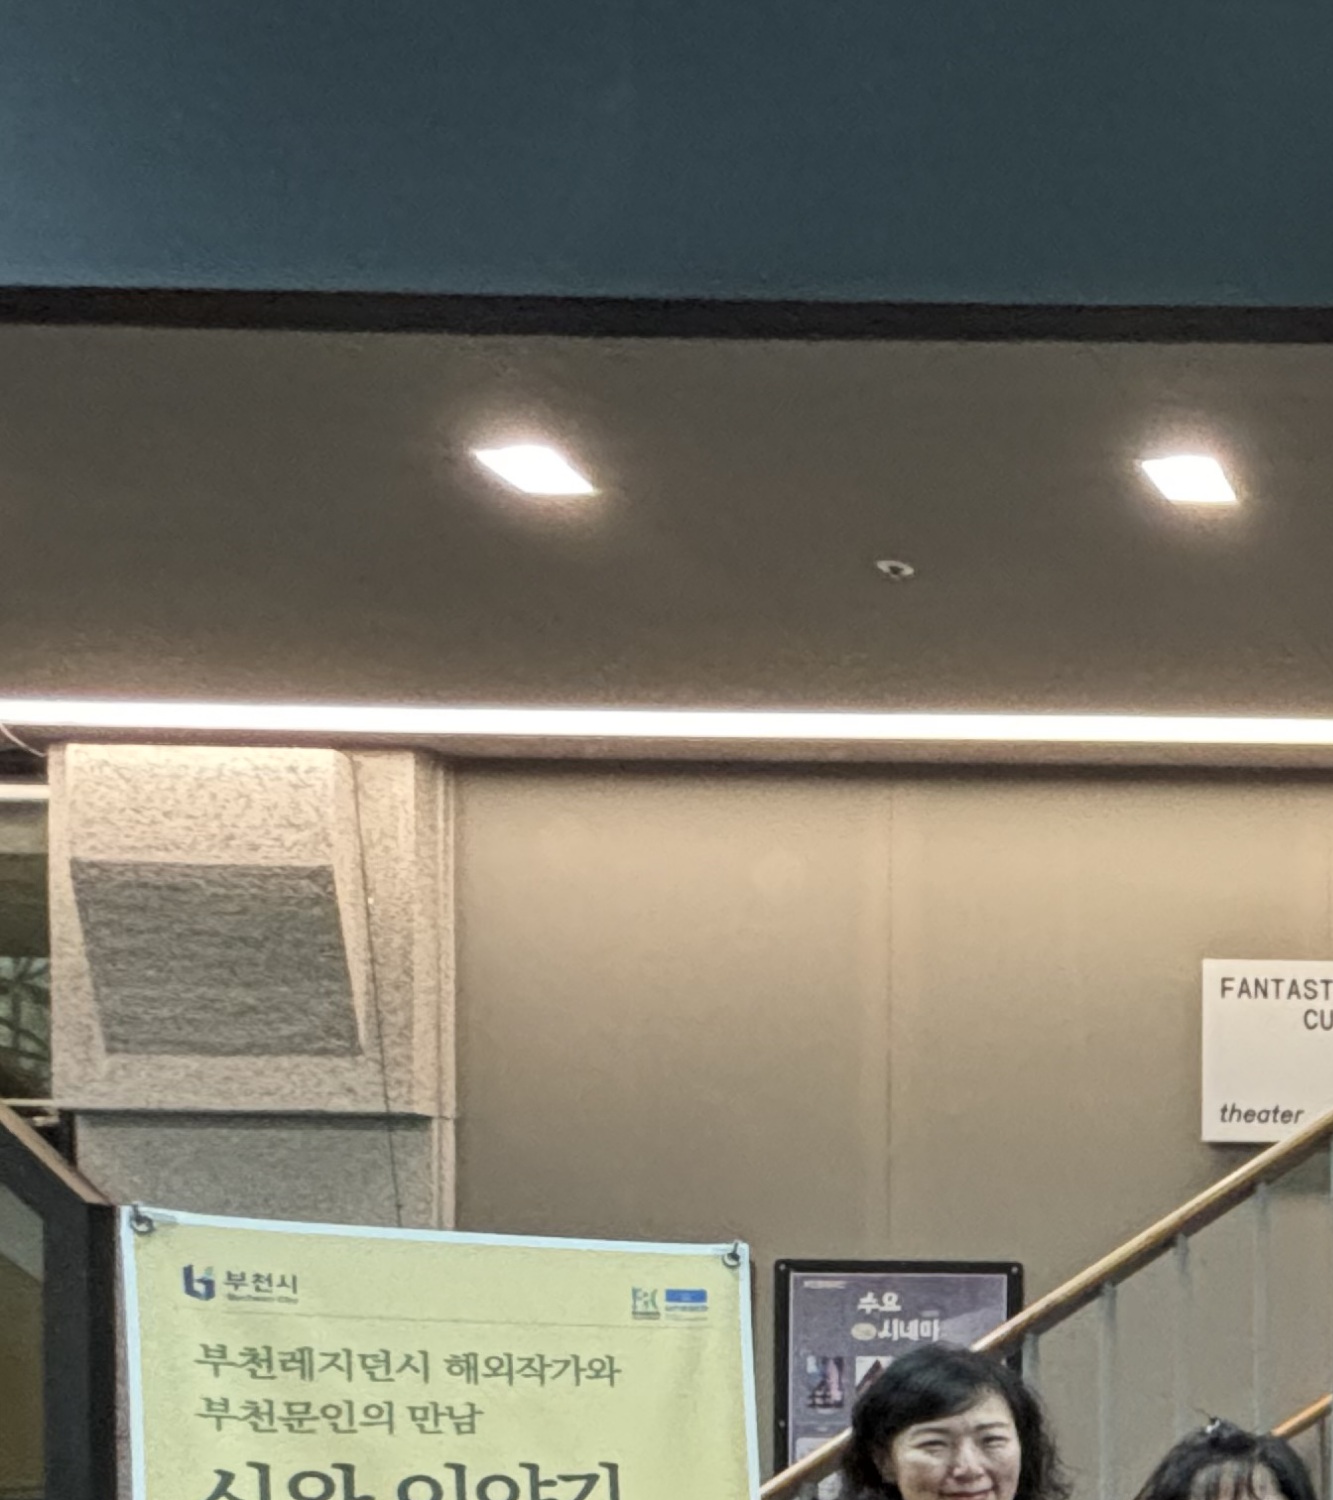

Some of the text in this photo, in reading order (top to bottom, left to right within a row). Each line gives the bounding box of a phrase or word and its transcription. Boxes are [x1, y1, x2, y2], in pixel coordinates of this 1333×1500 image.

[1219, 1103, 1305, 1124] theater
[222, 1270, 298, 1294] 부천시
[194, 1343, 621, 1387] 부천레지던시 해외작가와
[194, 1397, 484, 1436] 부천문인의 만남
